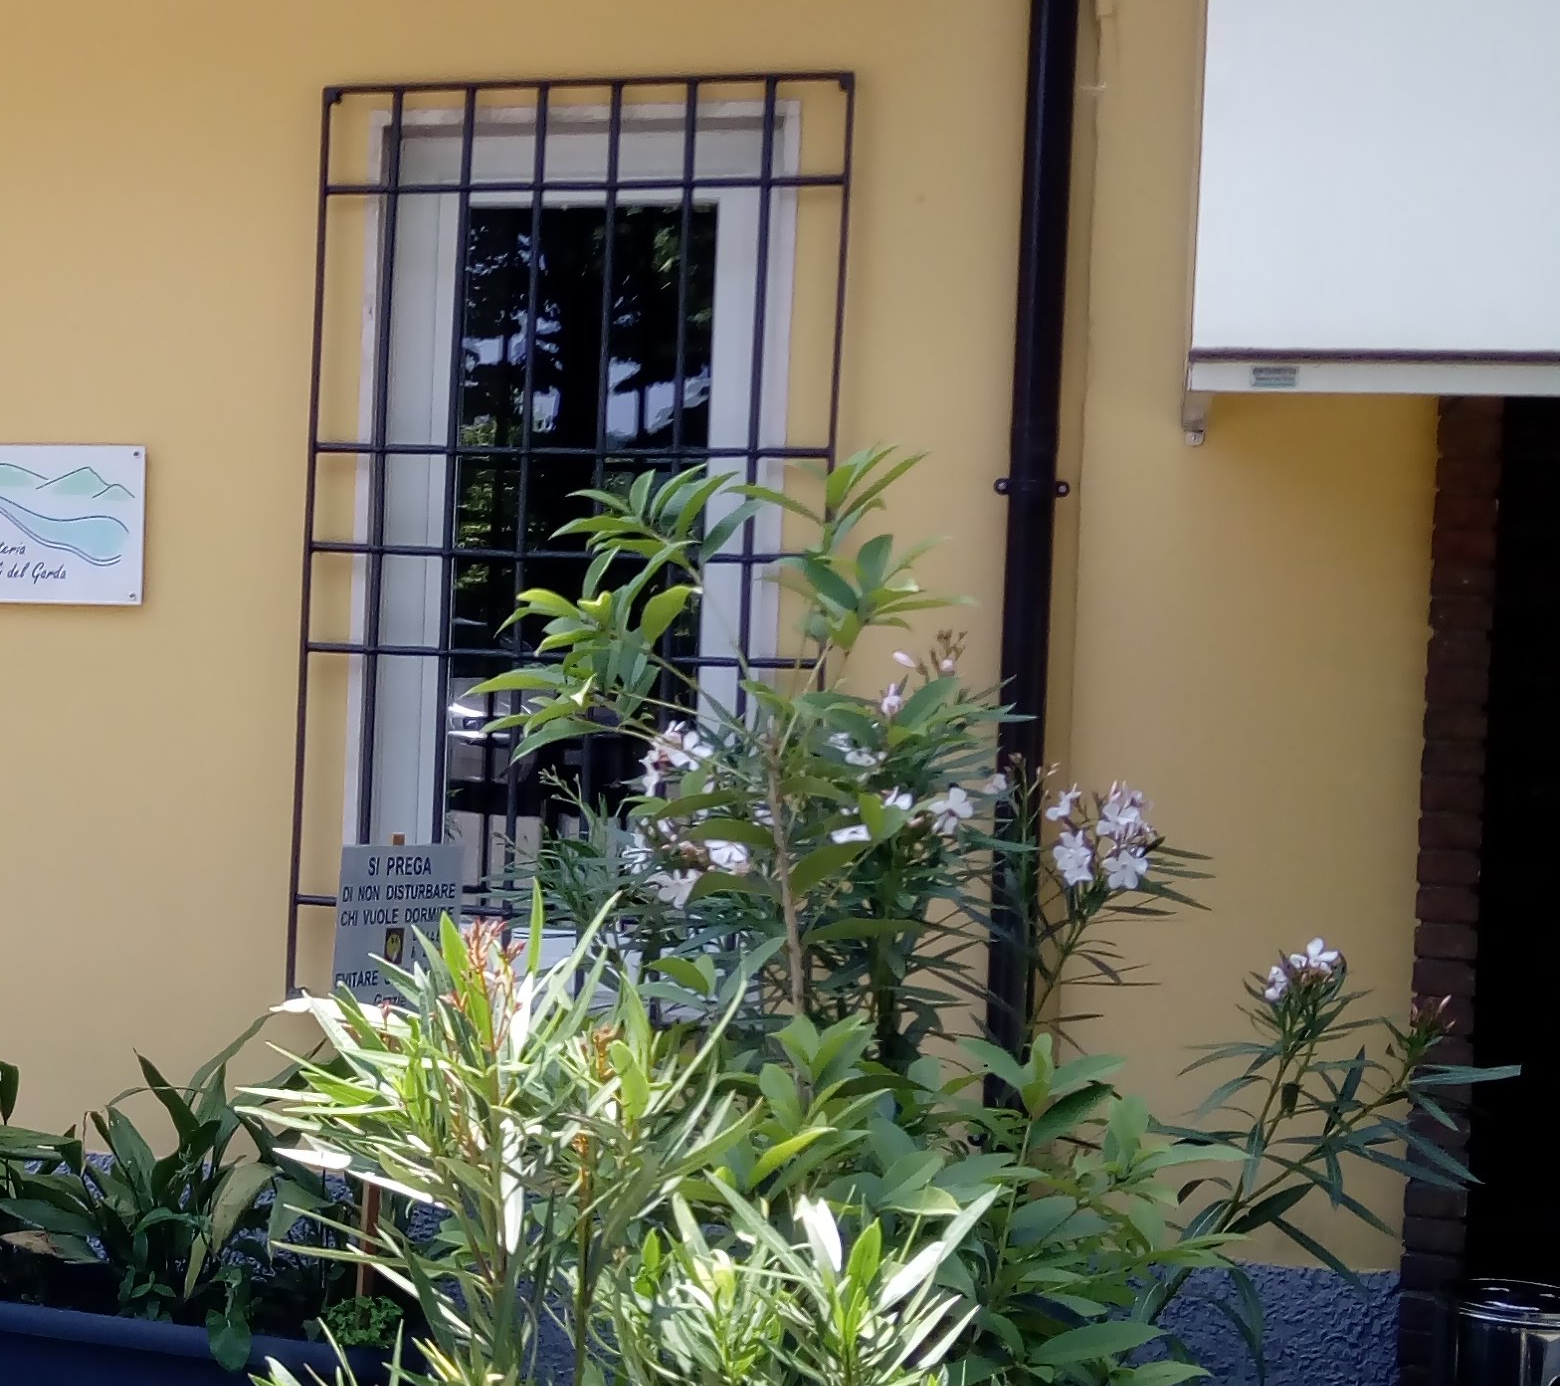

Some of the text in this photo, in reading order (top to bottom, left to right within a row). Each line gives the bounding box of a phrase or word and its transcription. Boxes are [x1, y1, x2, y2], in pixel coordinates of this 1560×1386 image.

[7, 562, 30, 578] del
[31, 561, 67, 585] Garda
[368, 856, 431, 876] SI PREGA
[342, 883, 456, 902] DI NON DISTURBARE
[341, 910, 358, 926] CHI
[363, 908, 399, 925] VUOLE
